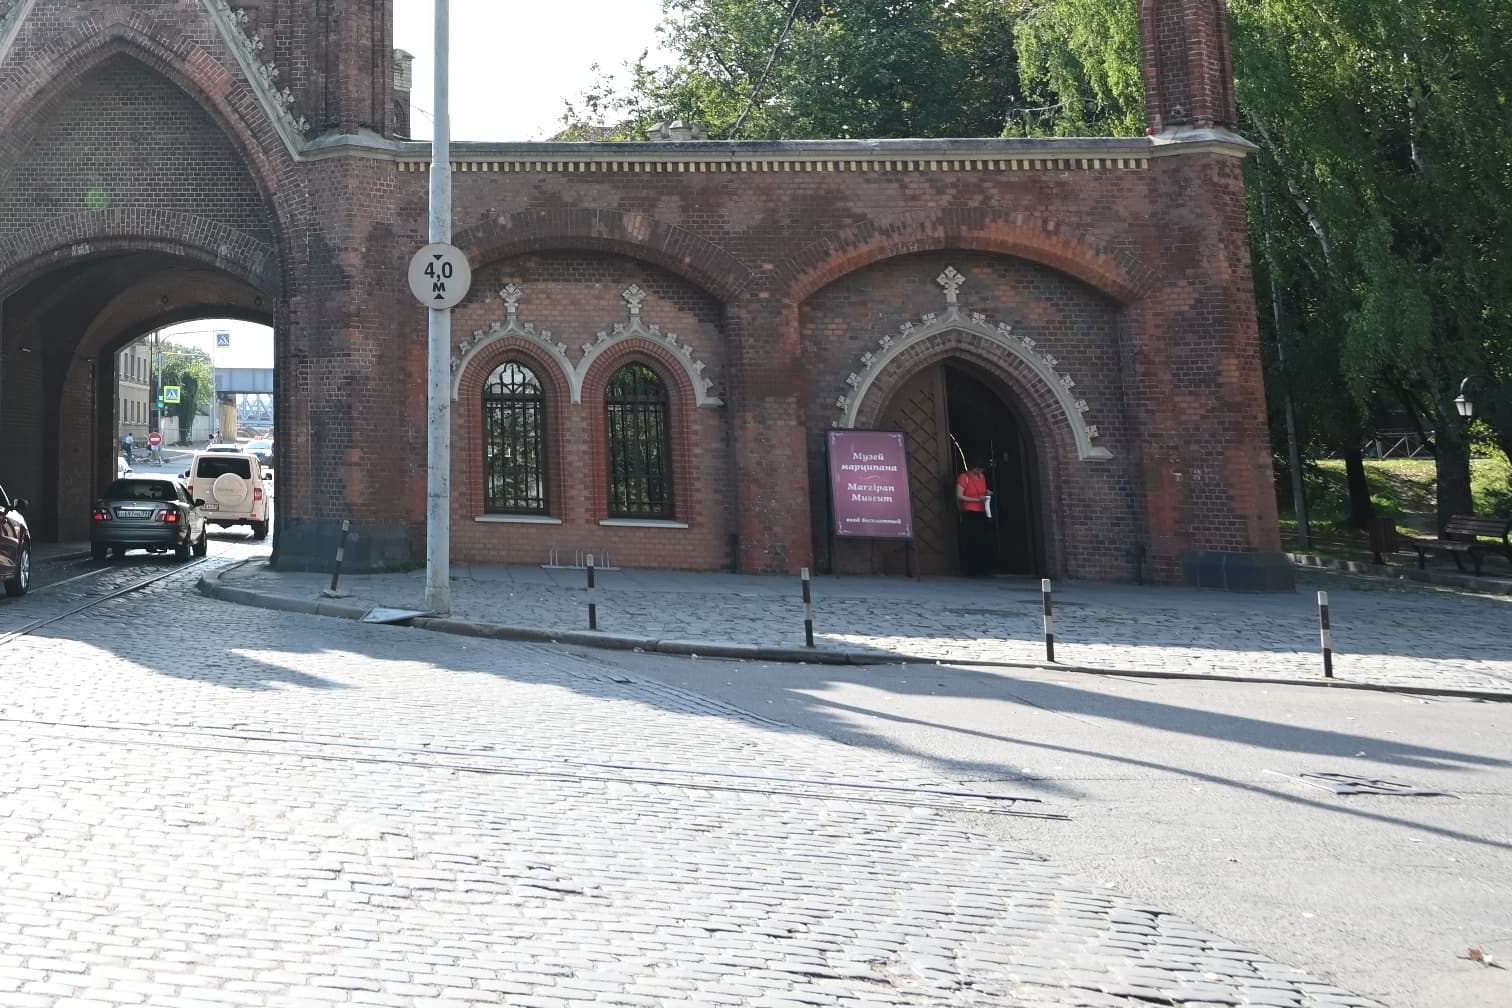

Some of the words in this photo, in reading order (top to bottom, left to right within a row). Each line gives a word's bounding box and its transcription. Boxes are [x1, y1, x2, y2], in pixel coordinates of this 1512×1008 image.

[424, 261, 453, 282] 4,0
[852, 452, 885, 462] Музей
[841, 463, 898, 472] марципана
[847, 483, 895, 493] Marzipan
[851, 493, 893, 503] Museum
